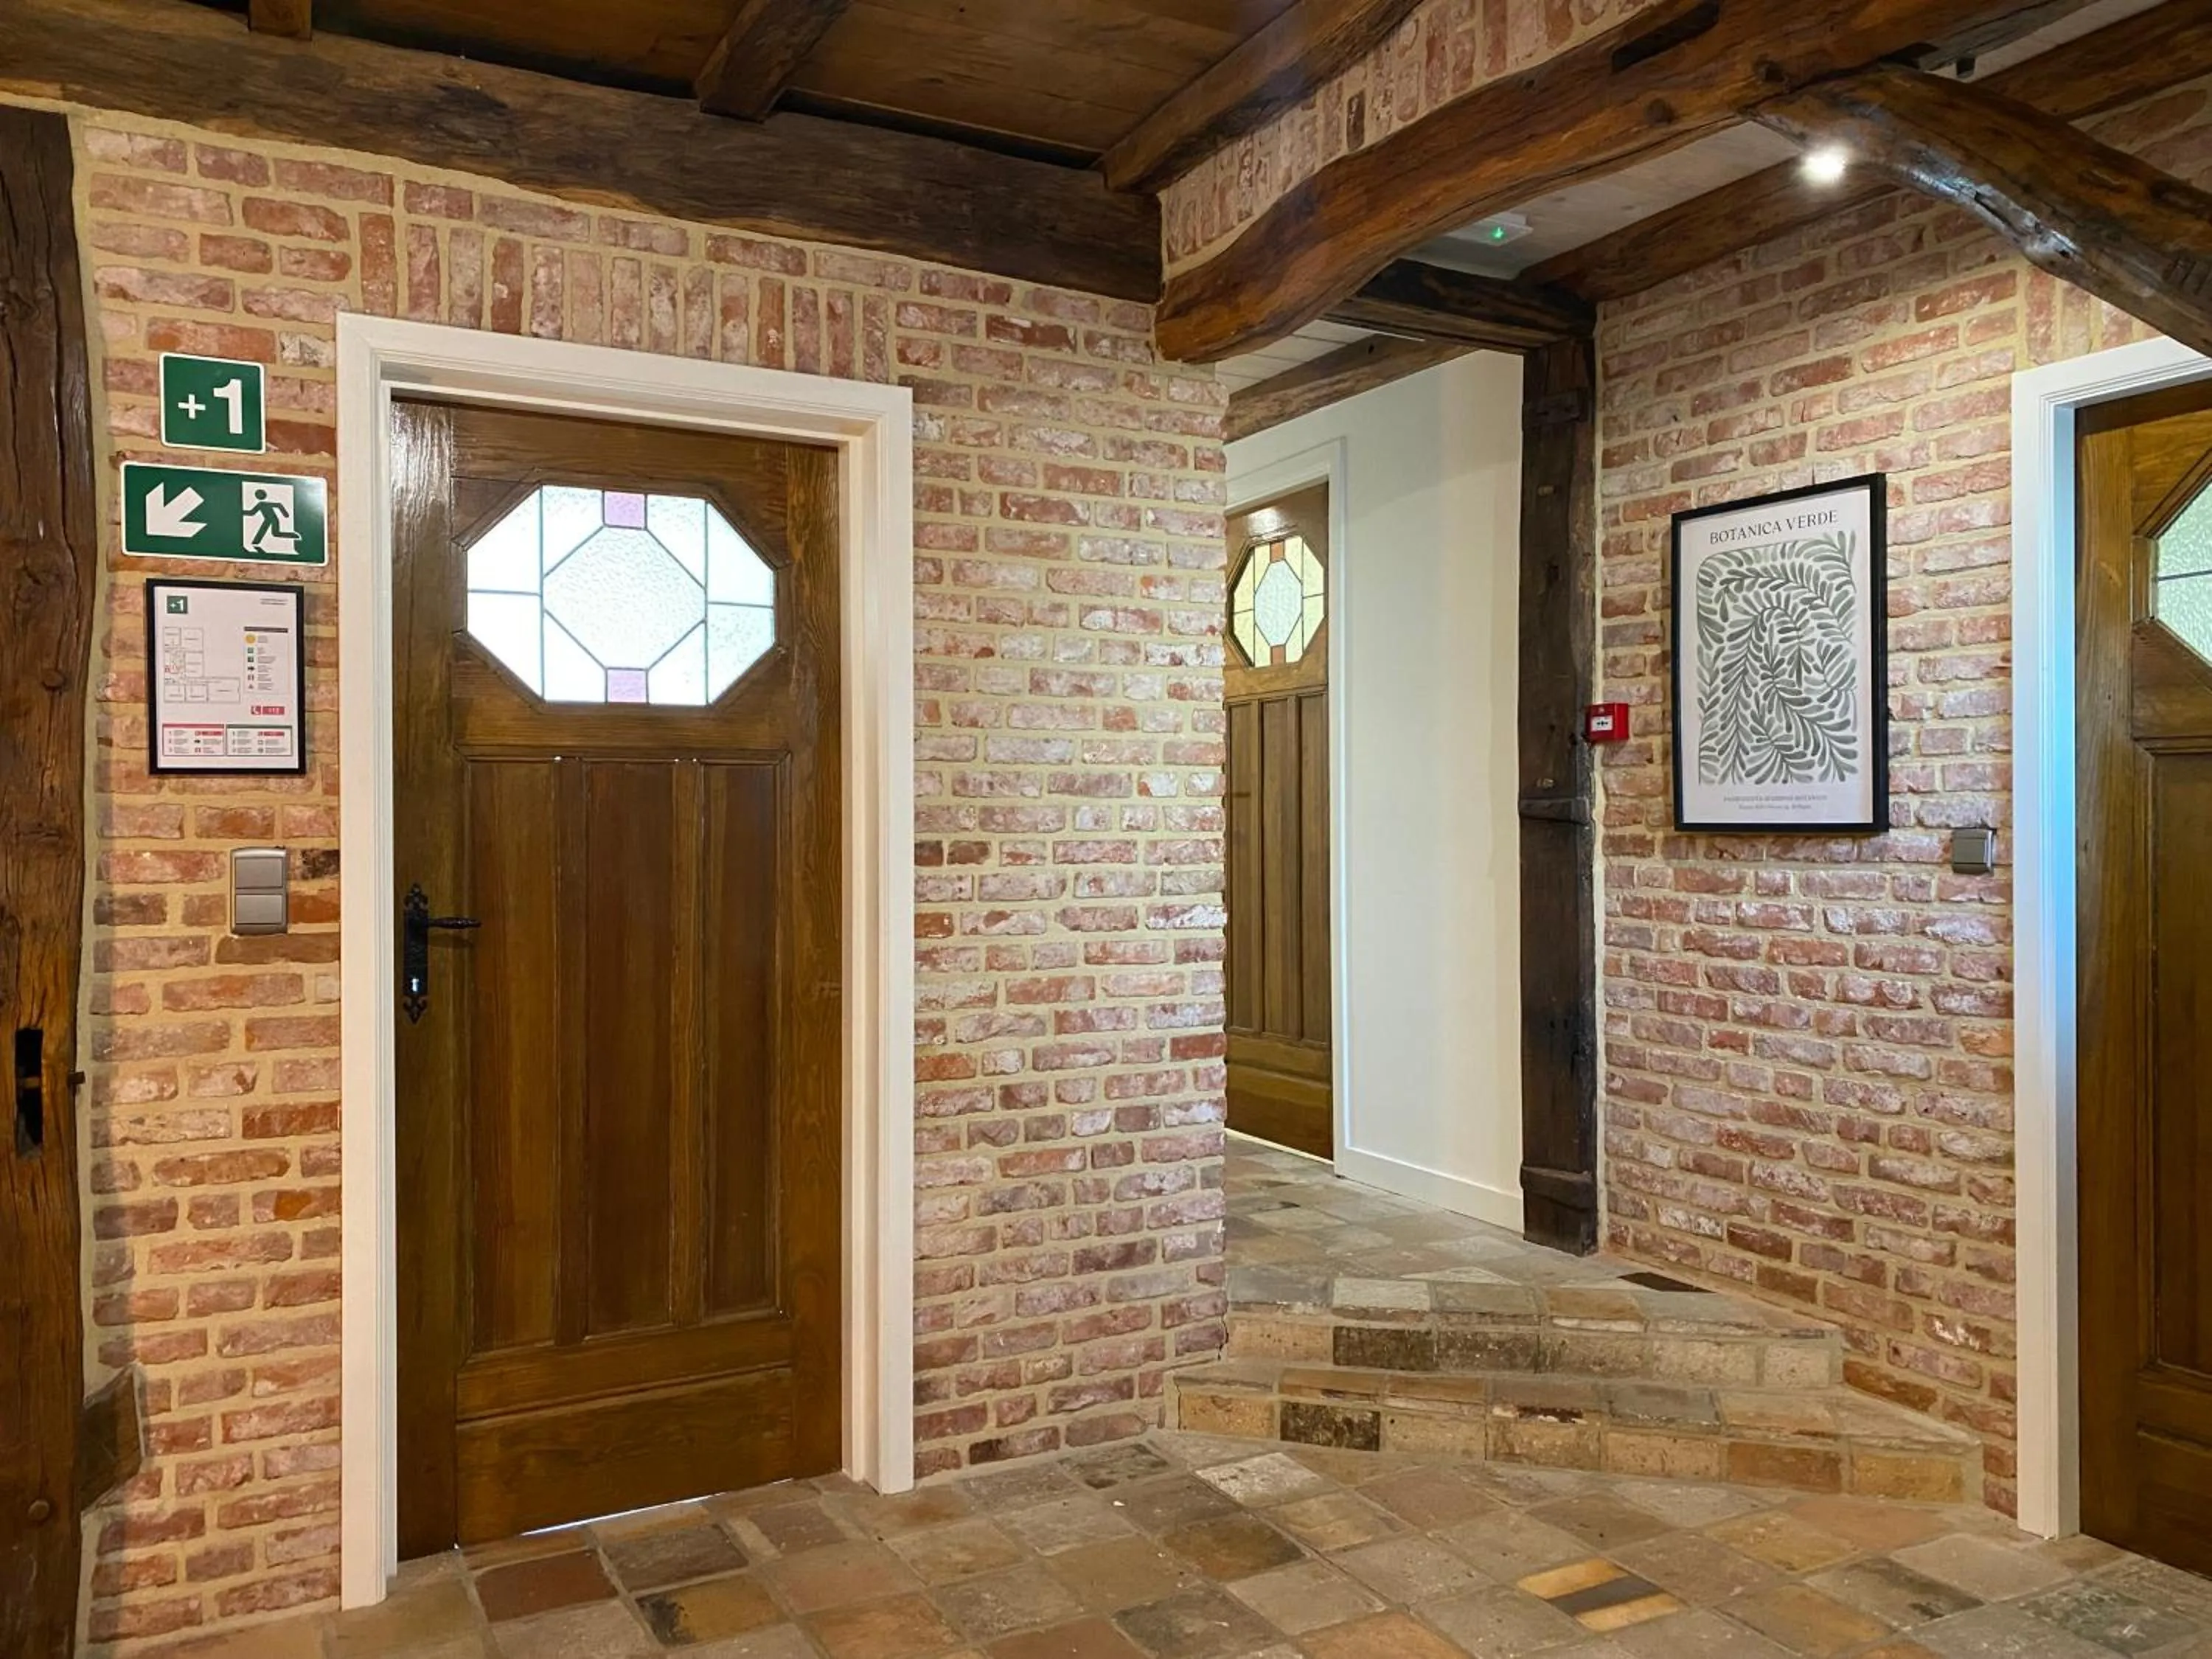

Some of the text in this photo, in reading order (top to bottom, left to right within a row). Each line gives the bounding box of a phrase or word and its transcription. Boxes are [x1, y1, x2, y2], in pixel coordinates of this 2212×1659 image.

[178, 378, 243, 434] +1
[1710, 509, 1838, 545] BOTANICA VERDE
